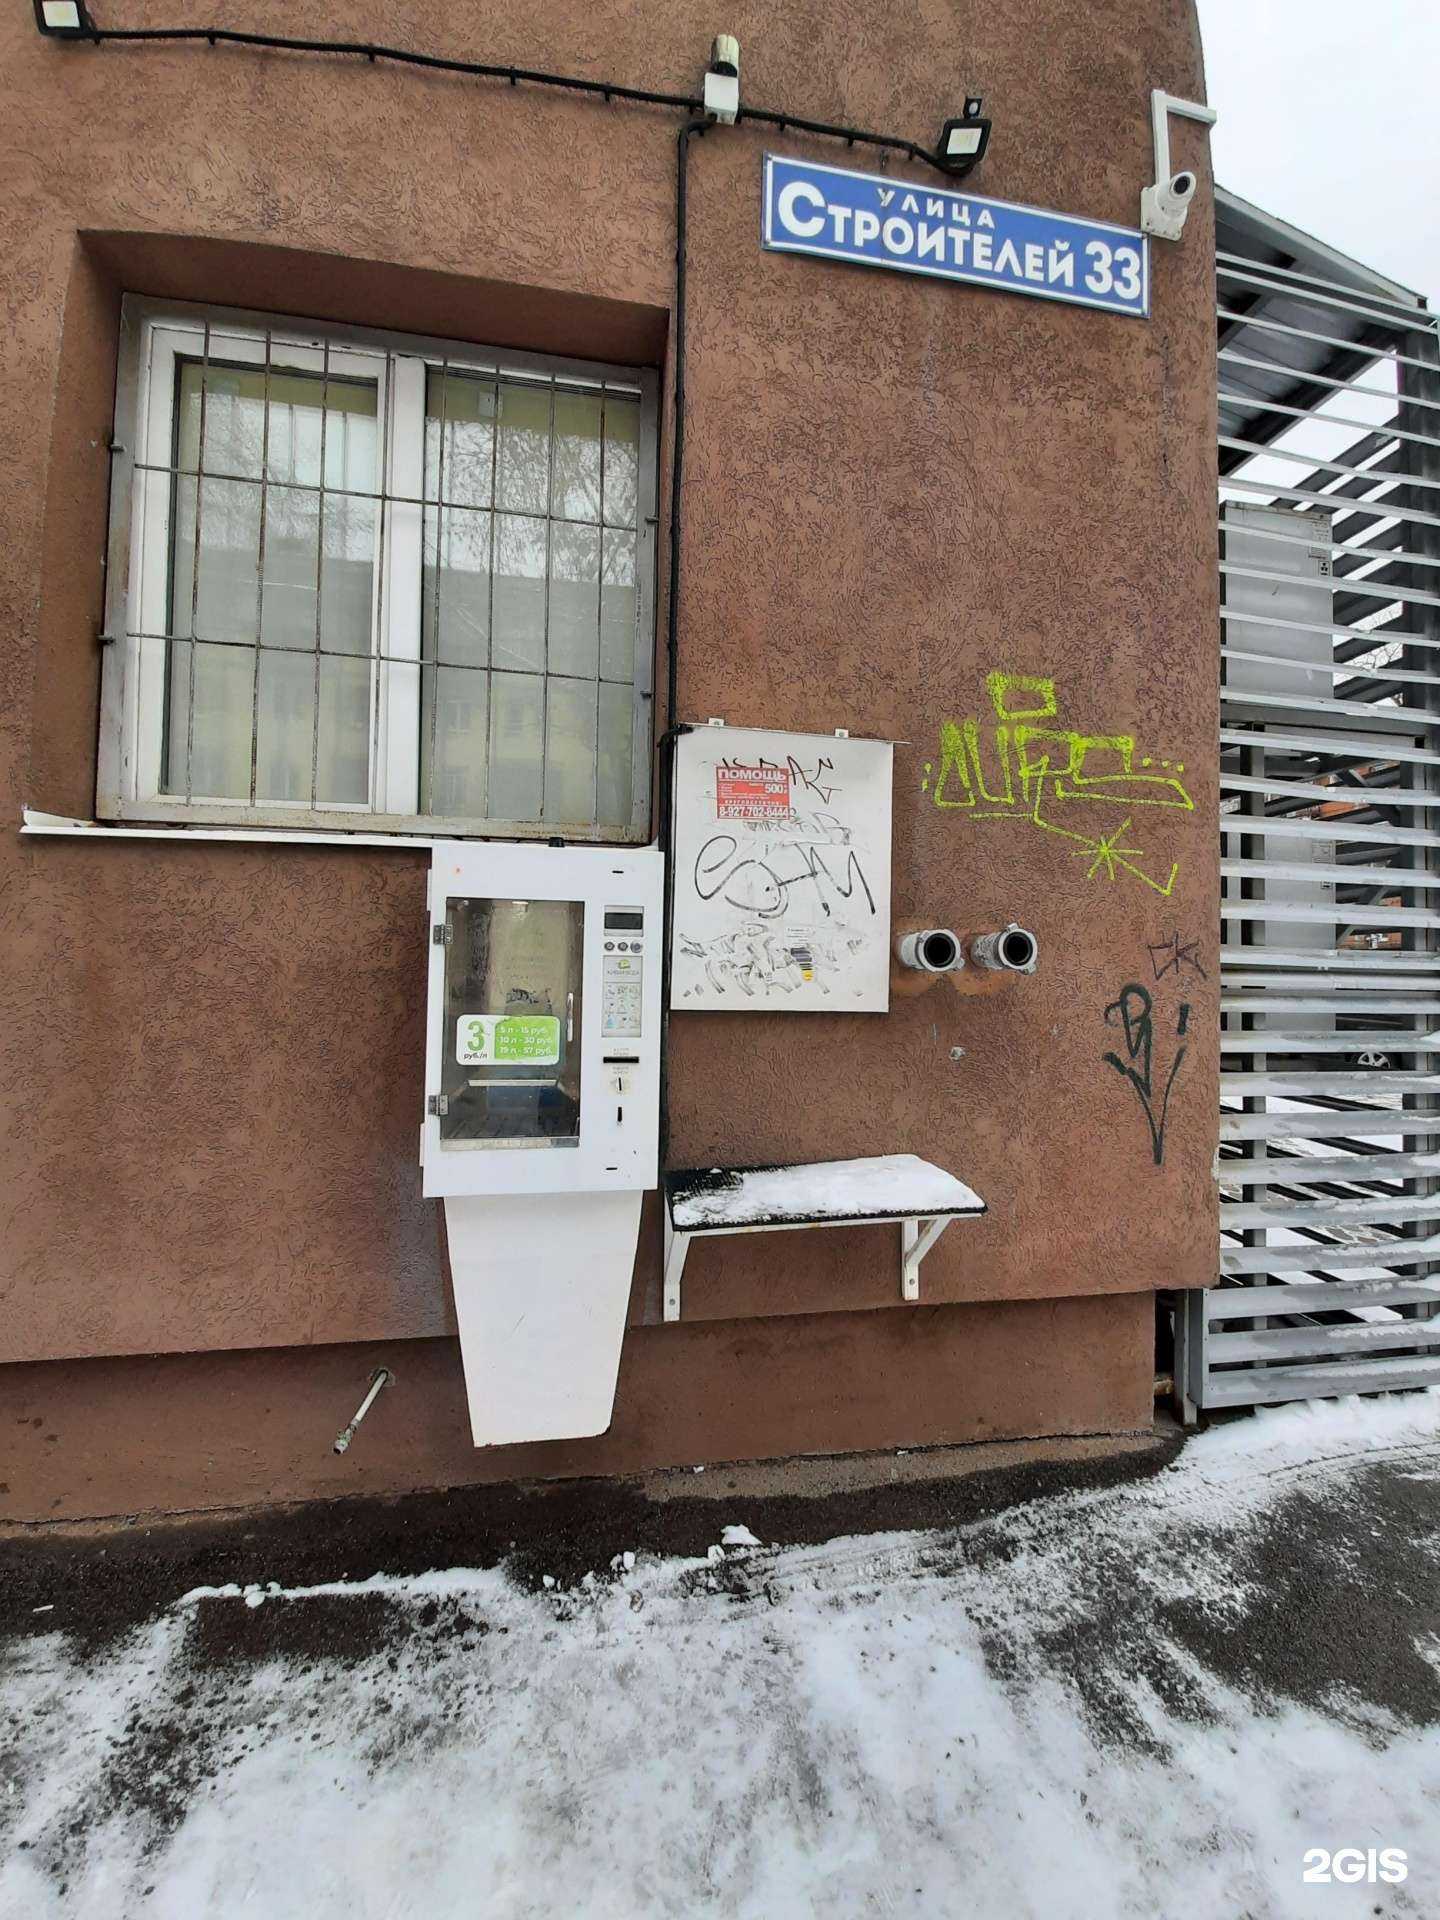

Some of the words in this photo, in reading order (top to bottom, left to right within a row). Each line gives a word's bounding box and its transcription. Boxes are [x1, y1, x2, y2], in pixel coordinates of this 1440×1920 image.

[877, 187, 996, 230] УЛИЦА
[777, 181, 1075, 289] СТРОИТЕЛЕЙ
[1084, 240, 1142, 301] 33
[717, 769, 787, 782] ПОМОЩЬ
[468, 1022, 484, 1052] 3
